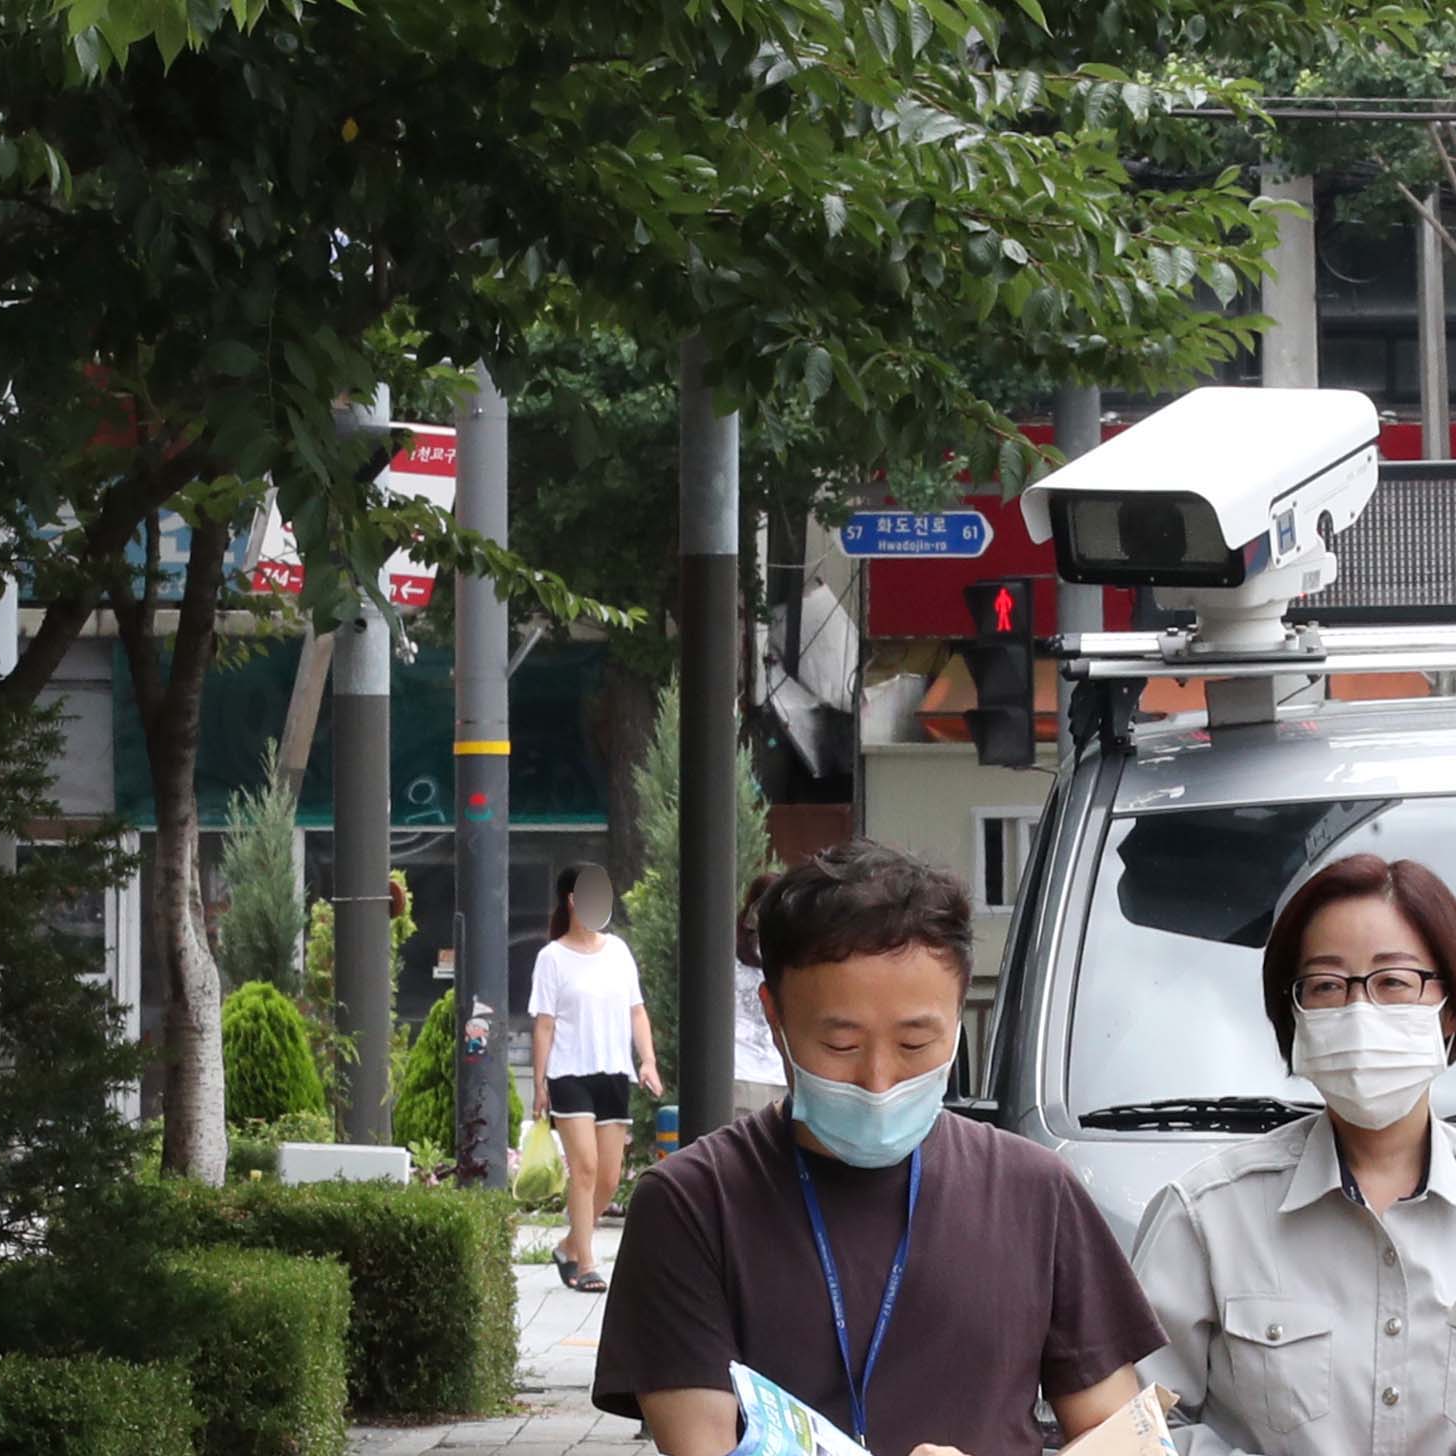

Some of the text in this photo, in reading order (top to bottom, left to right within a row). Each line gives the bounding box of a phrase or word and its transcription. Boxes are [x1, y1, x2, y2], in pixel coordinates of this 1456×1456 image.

[847, 525, 864, 540] 57
[877, 516, 947, 536] 화도진로
[962, 525, 978, 540] 61
[878, 540, 947, 553] Hwadojin-ro
